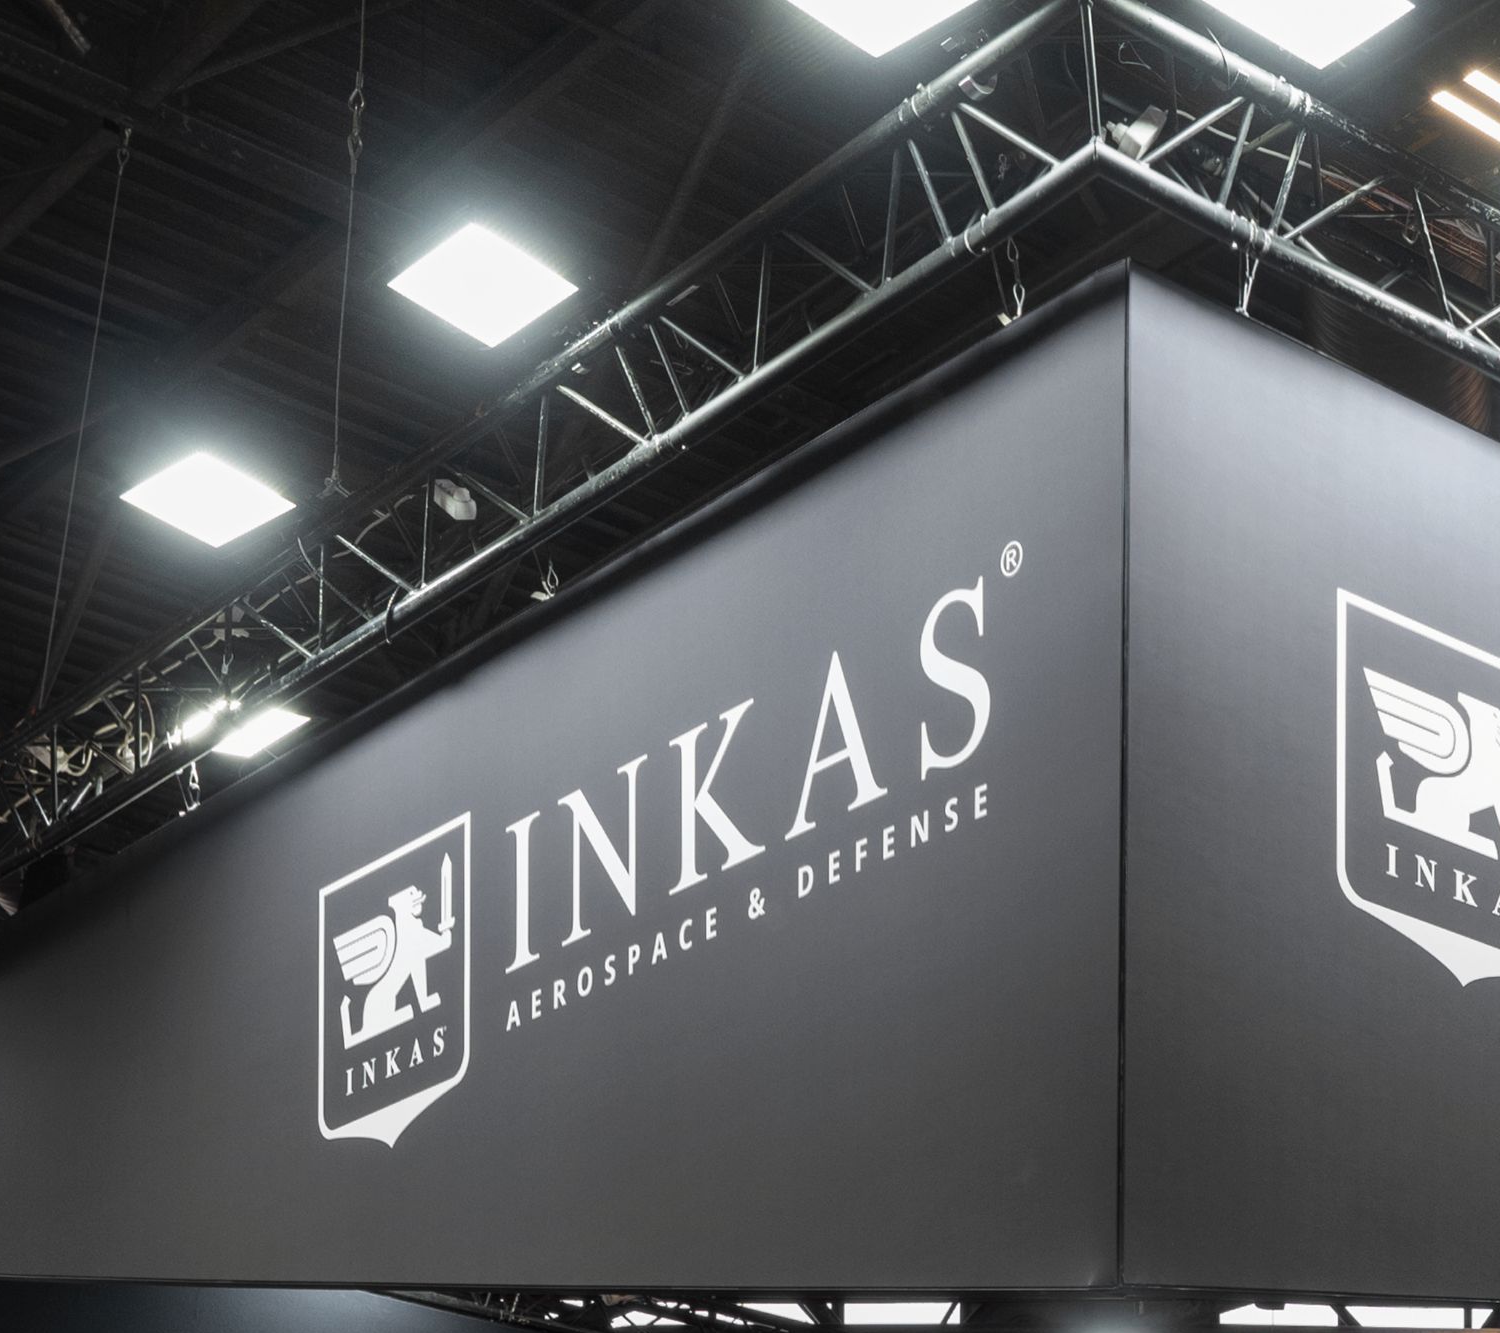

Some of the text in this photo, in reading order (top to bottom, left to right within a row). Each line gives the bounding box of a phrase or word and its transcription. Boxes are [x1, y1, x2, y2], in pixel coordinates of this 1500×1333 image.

[506, 784, 990, 1032] AEROSPACE & DEFENSE
